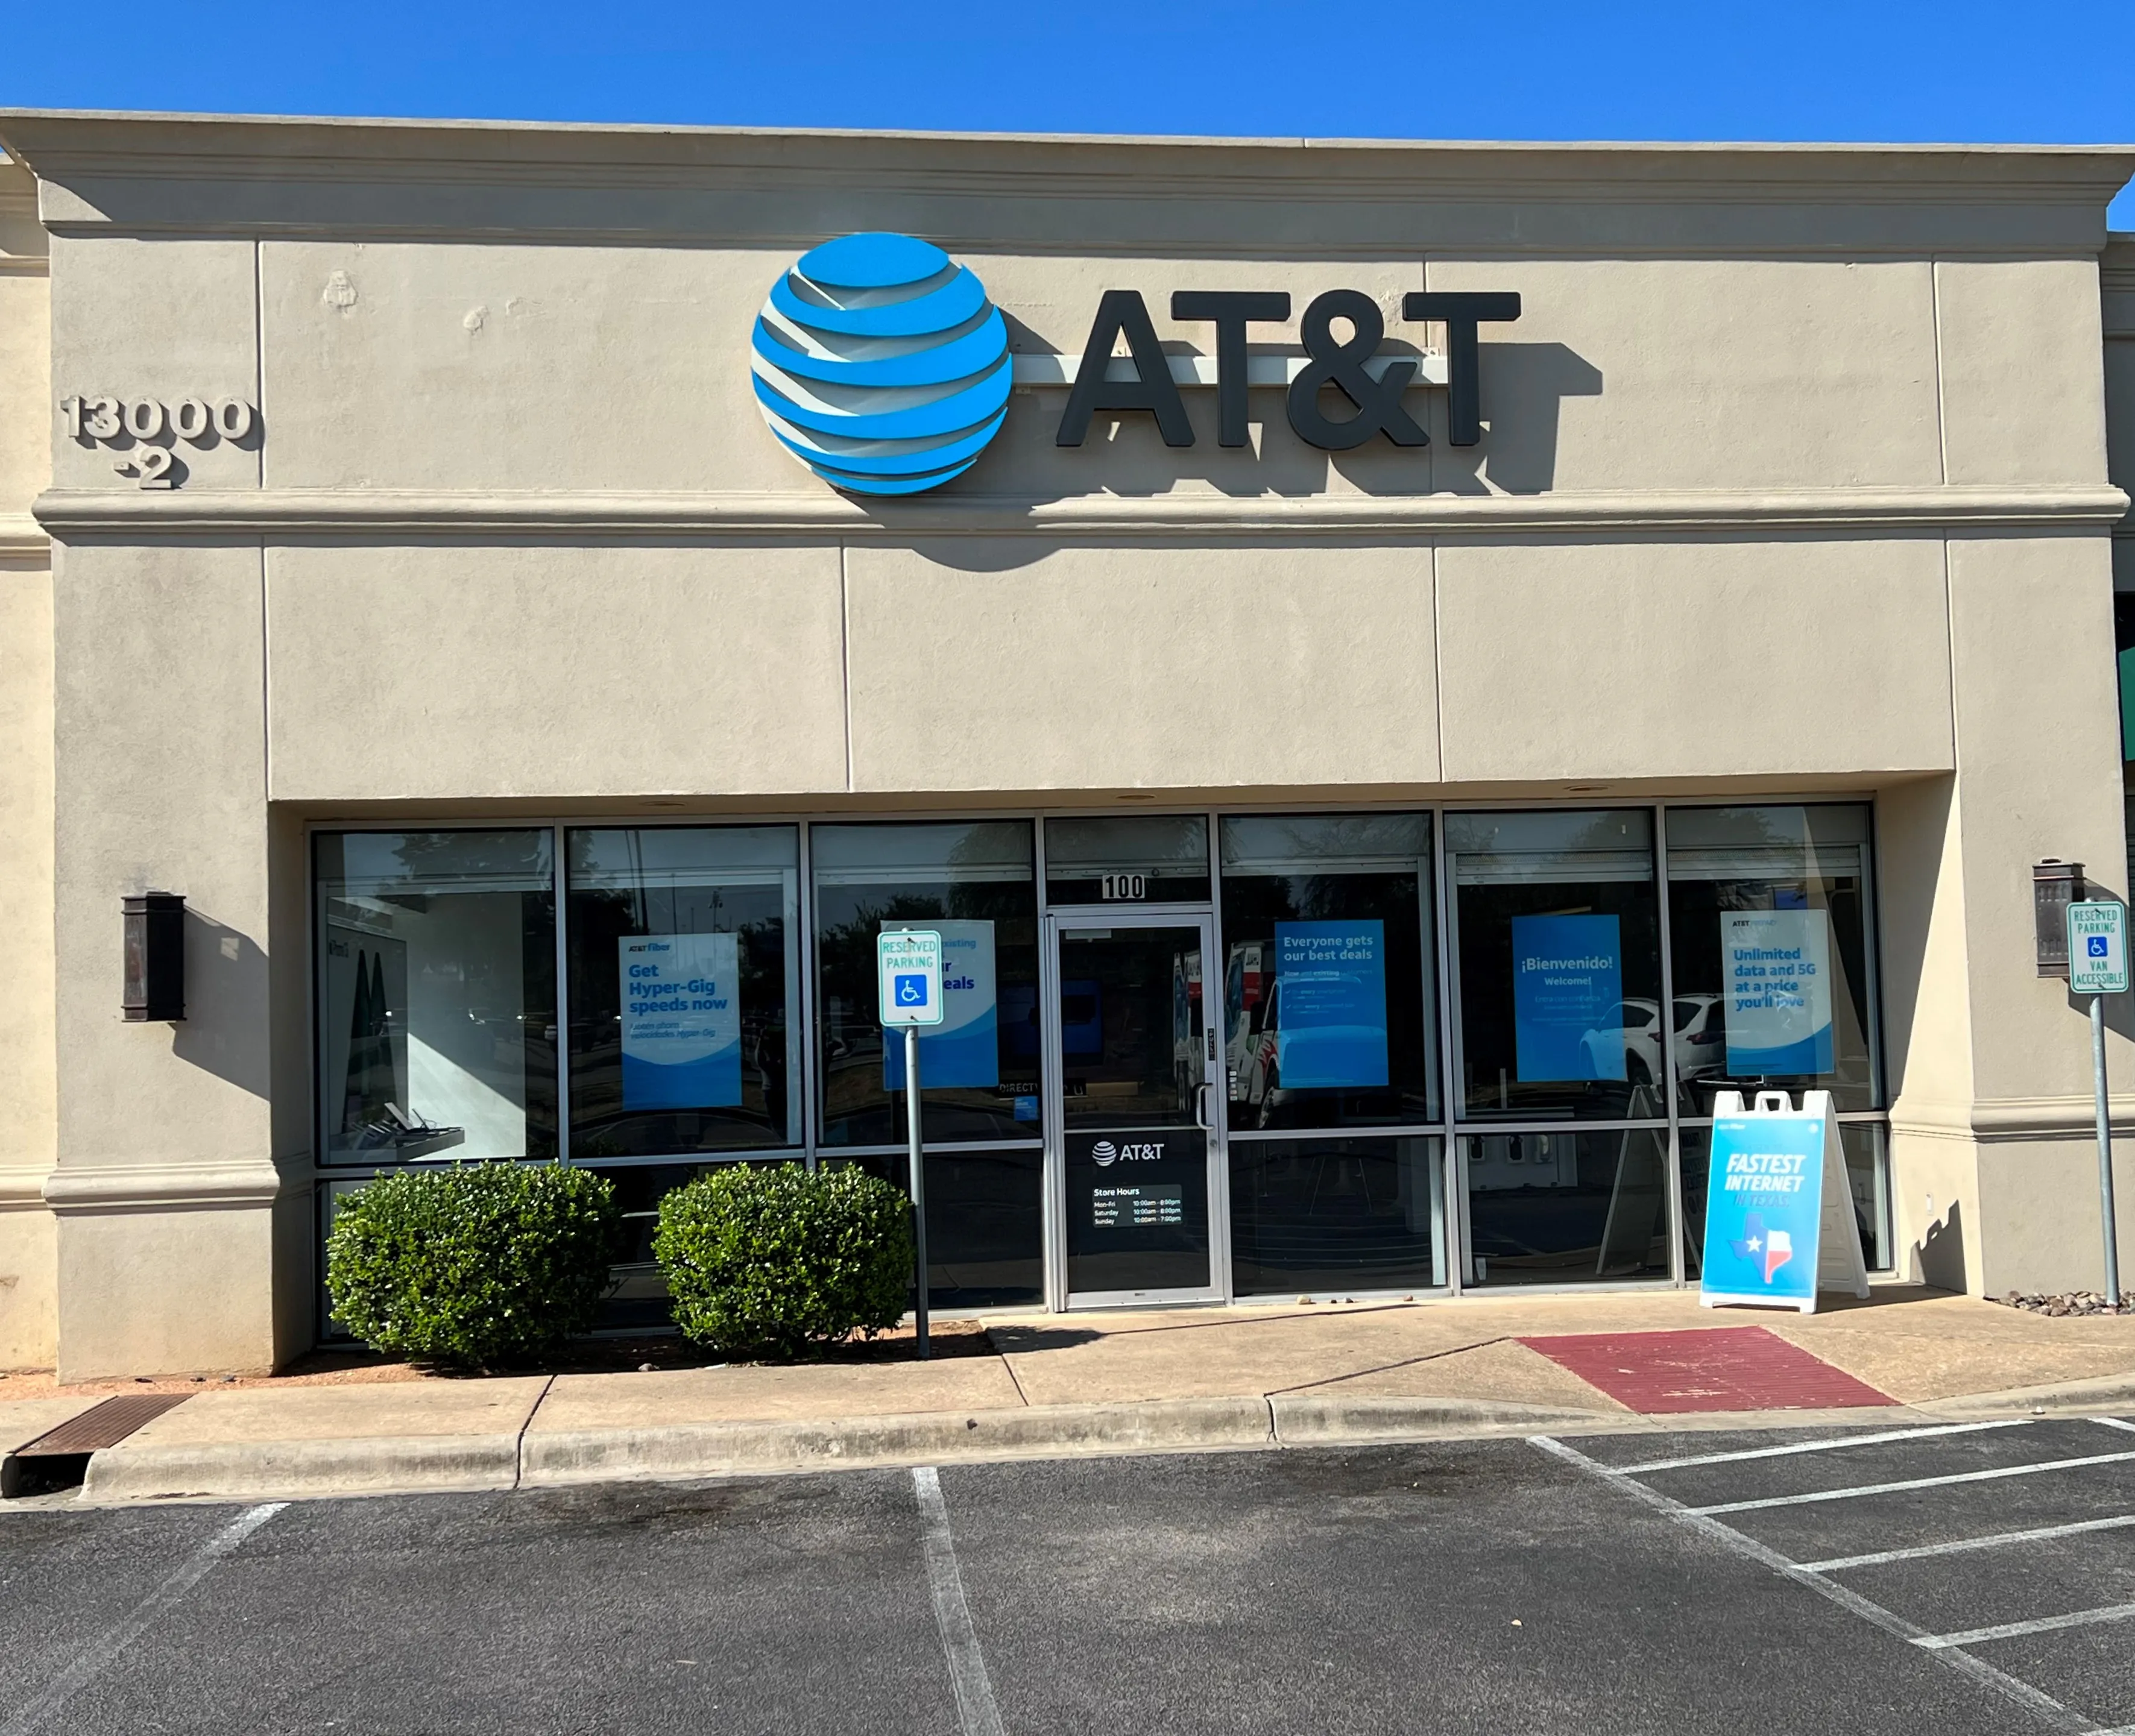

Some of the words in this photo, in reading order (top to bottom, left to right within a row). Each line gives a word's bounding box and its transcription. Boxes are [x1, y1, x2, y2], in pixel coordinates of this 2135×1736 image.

[1055, 289, 1521, 451] AT&T
[61, 395, 251, 439] 13000
[1105, 875, 1143, 898] 100
[2074, 910, 2118, 921] RESERVED
[2078, 922, 2115, 934] PARKING
[883, 940, 936, 953] RESERVED
[941, 939, 976, 949] xisting
[1284, 937, 1342, 949] Everyone
[1346, 936, 1373, 948] gets
[1284, 952, 1305, 961] our
[1308, 950, 1336, 960] best
[1340, 949, 1372, 960] deals
[1734, 948, 1800, 960] Unlimited
[887, 956, 933, 969] PARKING
[1522, 955, 1613, 973] ¡Bienvenido!
[2090, 961, 2107, 972] VAN
[629, 964, 659, 978] Get
[1735, 964, 1765, 976] data
[1770, 963, 1794, 975] and
[1799, 963, 1815, 975] 5G
[943, 976, 974, 989] eals
[1544, 976, 1592, 985] Welcome!
[2076, 973, 2123, 984] ACCESSIBLE
[629, 979, 715, 998] Hyper-Gig
[1735, 981, 1750, 992] at
[1753, 983, 1761, 992] a
[1765, 979, 1799, 995] price
[629, 998, 689, 1016] speeds
[692, 999, 727, 1010] now
[1735, 996, 1773, 1011] you'll
[1776, 996, 1805, 1007] love
[1120, 1143, 1164, 1161] AT&T
[1726, 1154, 1807, 1174] FASTEST
[1724, 1175, 1805, 1192] INTERNET
[1733, 1194, 1745, 1206] IN
